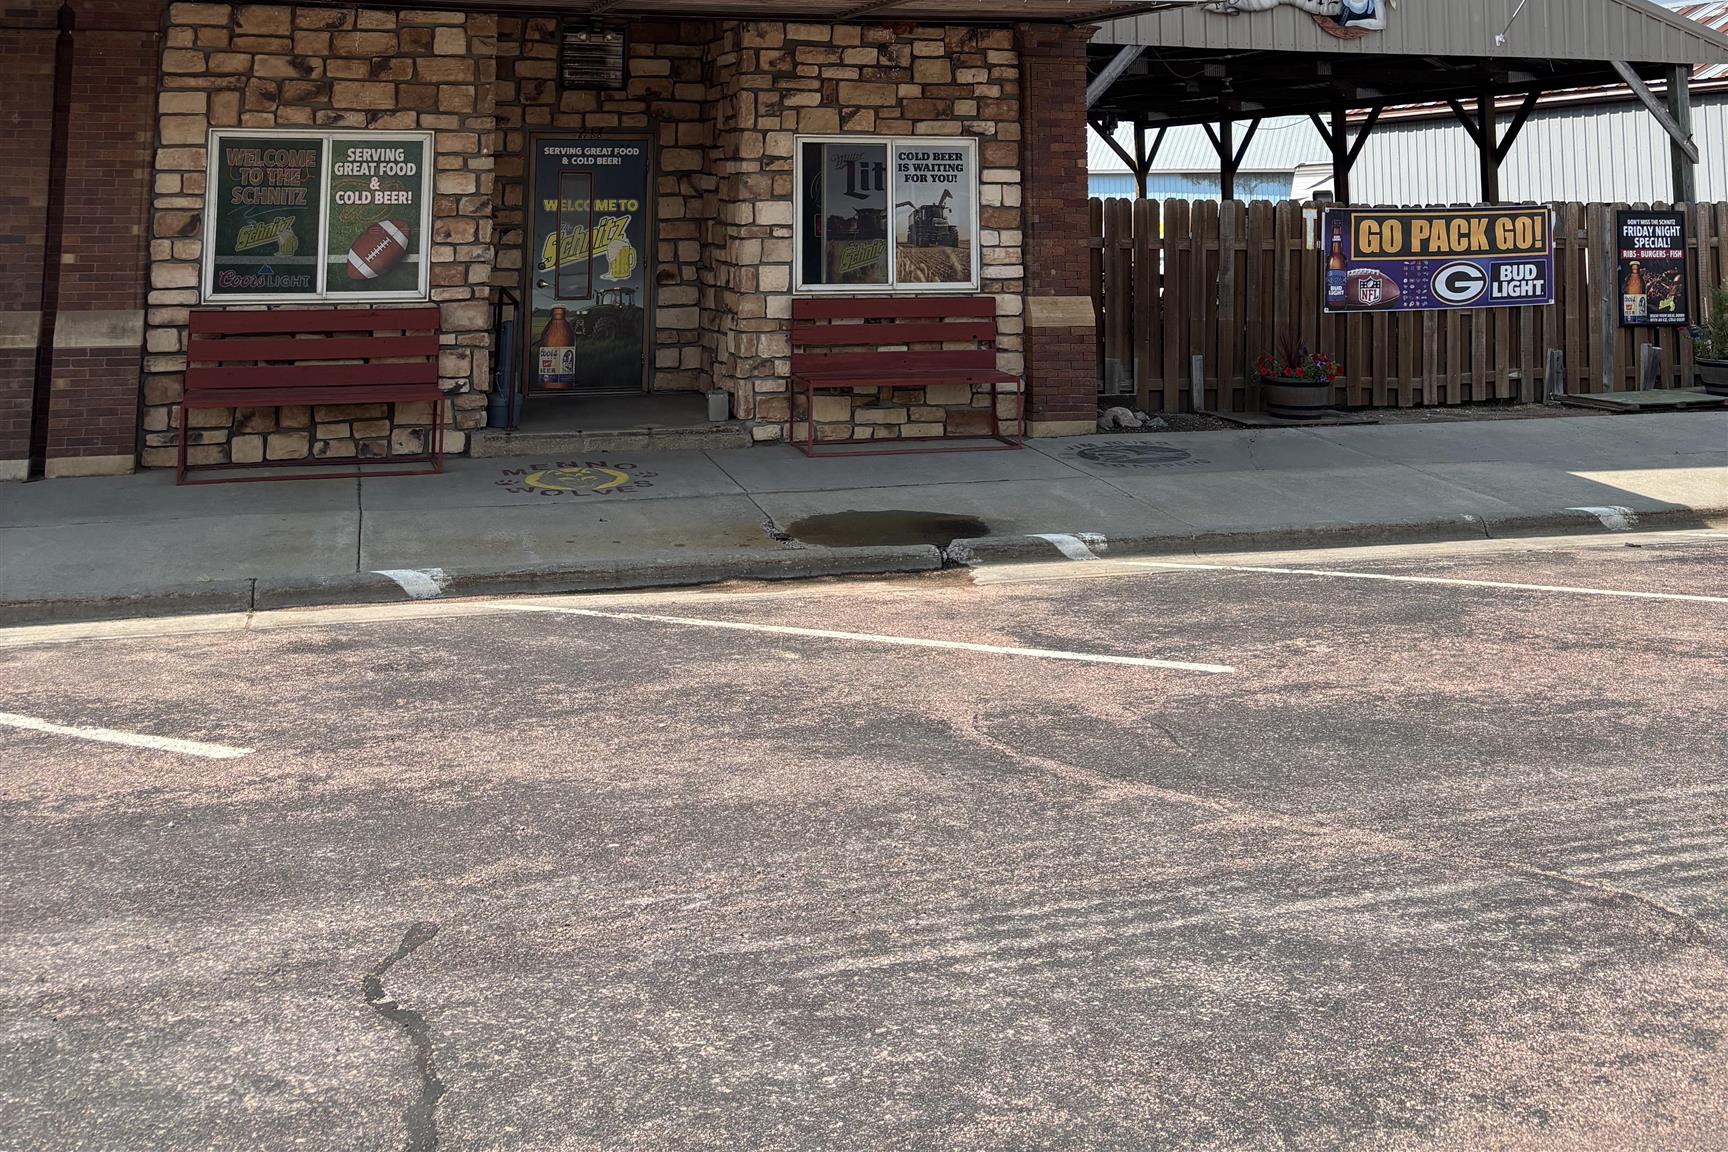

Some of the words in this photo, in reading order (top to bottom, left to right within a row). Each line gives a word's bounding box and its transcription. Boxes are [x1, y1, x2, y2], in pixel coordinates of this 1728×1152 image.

[225, 148, 317, 167] WELCOME
[347, 148, 404, 161] SERVING
[544, 147, 582, 155] SERVING
[584, 147, 612, 155] GREAT
[614, 147, 639, 156] FOOD
[898, 152, 930, 161] COLD
[933, 152, 963, 161] BEER
[571, 157, 594, 165] COLD
[596, 157, 621, 165] BEER!
[898, 163, 910, 172] IS
[911, 163, 964, 172] WAITING
[334, 163, 377, 176] GREAT
[379, 163, 416, 176] FOOD
[240, 168, 263, 186] TO
[267, 168, 301, 186] THE
[370, 177, 380, 190] &
[904, 174, 928, 183] FOR
[929, 174, 957, 183] YOU!
[231, 186, 307, 206] SCHNITZ
[336, 191, 371, 204] COLD
[374, 191, 412, 204] BEER!
[543, 199, 617, 212] WELCOME
[619, 199, 639, 212] TO
[1359, 219, 1402, 254] GO
[1410, 217, 1492, 253] PACK
[1495, 215, 1542, 250] GO!
[1623, 226, 1655, 237] FRIDAY
[1655, 226, 1681, 237] NIGHT
[541, 214, 632, 270] Schnitz
[1634, 237, 1671, 248] SPECIAL!
[1623, 250, 1637, 258] RIBS
[1640, 250, 1666, 258] BURGERS
[1670, 250, 1682, 258] FISH
[218, 269, 265, 288] Coors
[267, 275, 310, 288] LIGHT
[1500, 264, 1537, 281] BUD
[1361, 289, 1379, 301] NFL
[502, 461, 638, 476] MENNO
[505, 480, 654, 496] WOLVES
